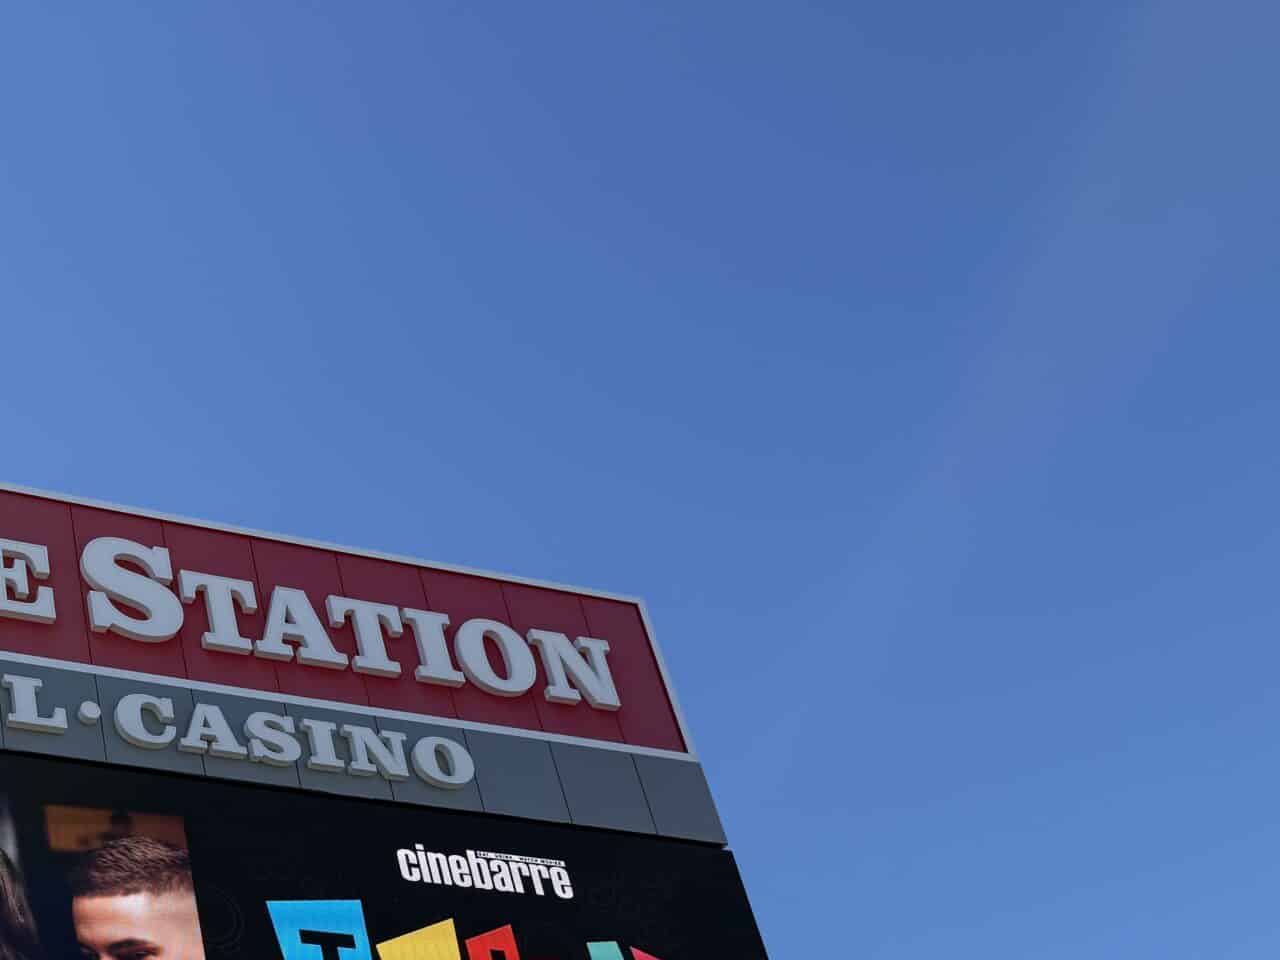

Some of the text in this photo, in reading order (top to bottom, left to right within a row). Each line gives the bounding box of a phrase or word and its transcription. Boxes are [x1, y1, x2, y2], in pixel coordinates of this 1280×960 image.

[80, 536, 622, 711] STATION
[113, 692, 476, 791] CASINO
[397, 843, 574, 899] cinebarre
